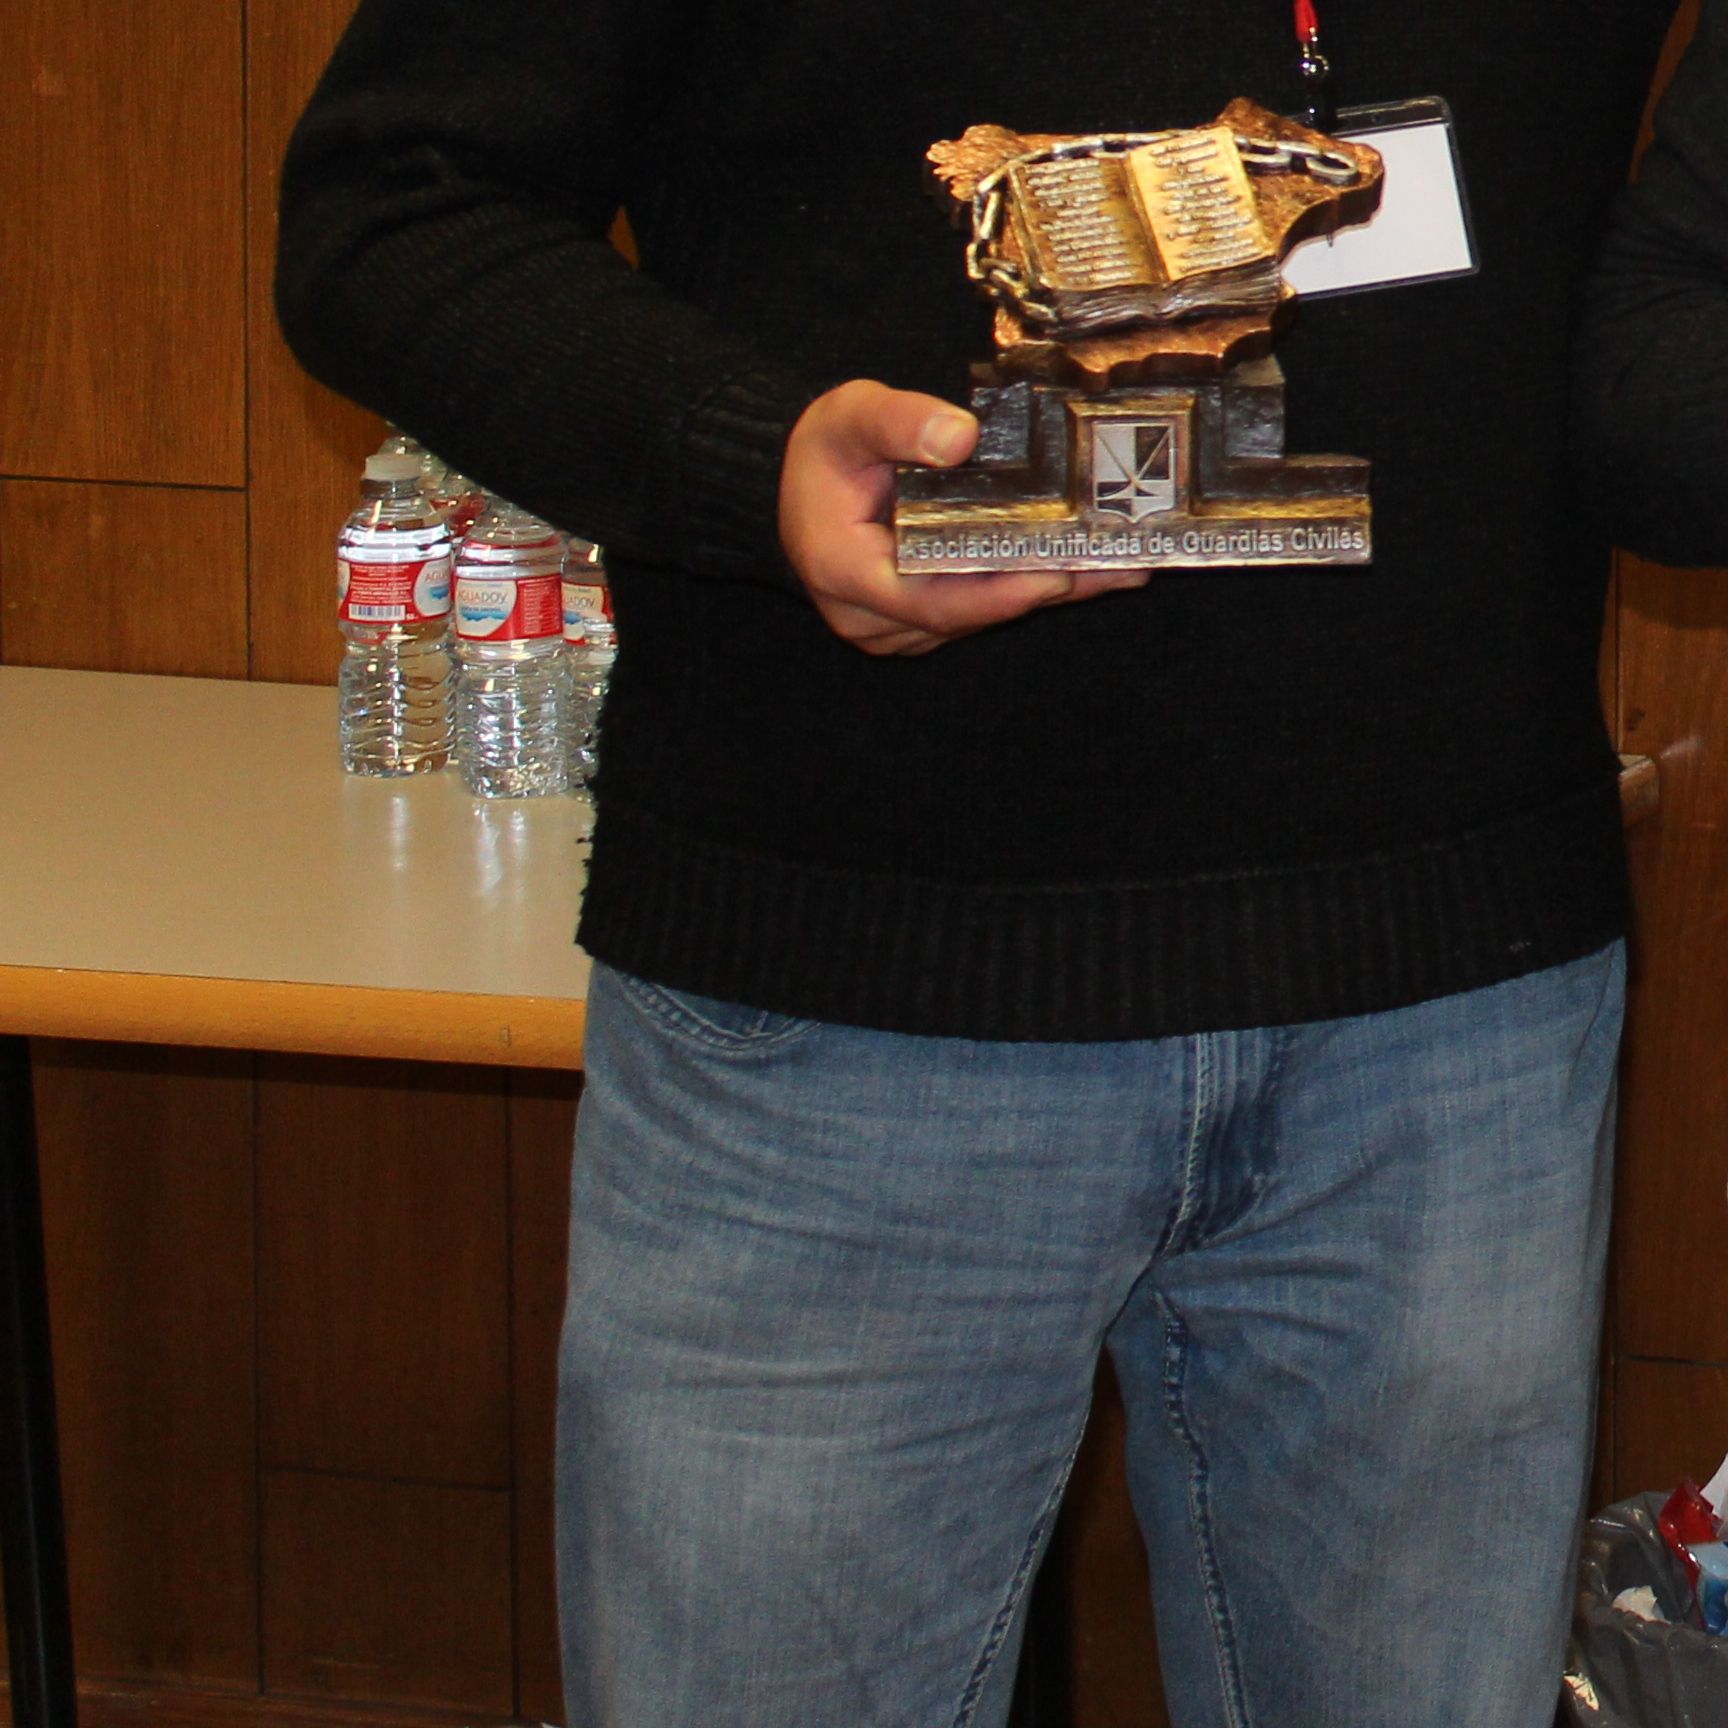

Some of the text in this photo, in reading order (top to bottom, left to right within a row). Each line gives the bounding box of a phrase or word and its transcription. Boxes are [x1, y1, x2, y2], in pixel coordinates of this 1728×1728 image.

[902, 524, 1366, 560] Asociación Unificada de Guardias Civiles
